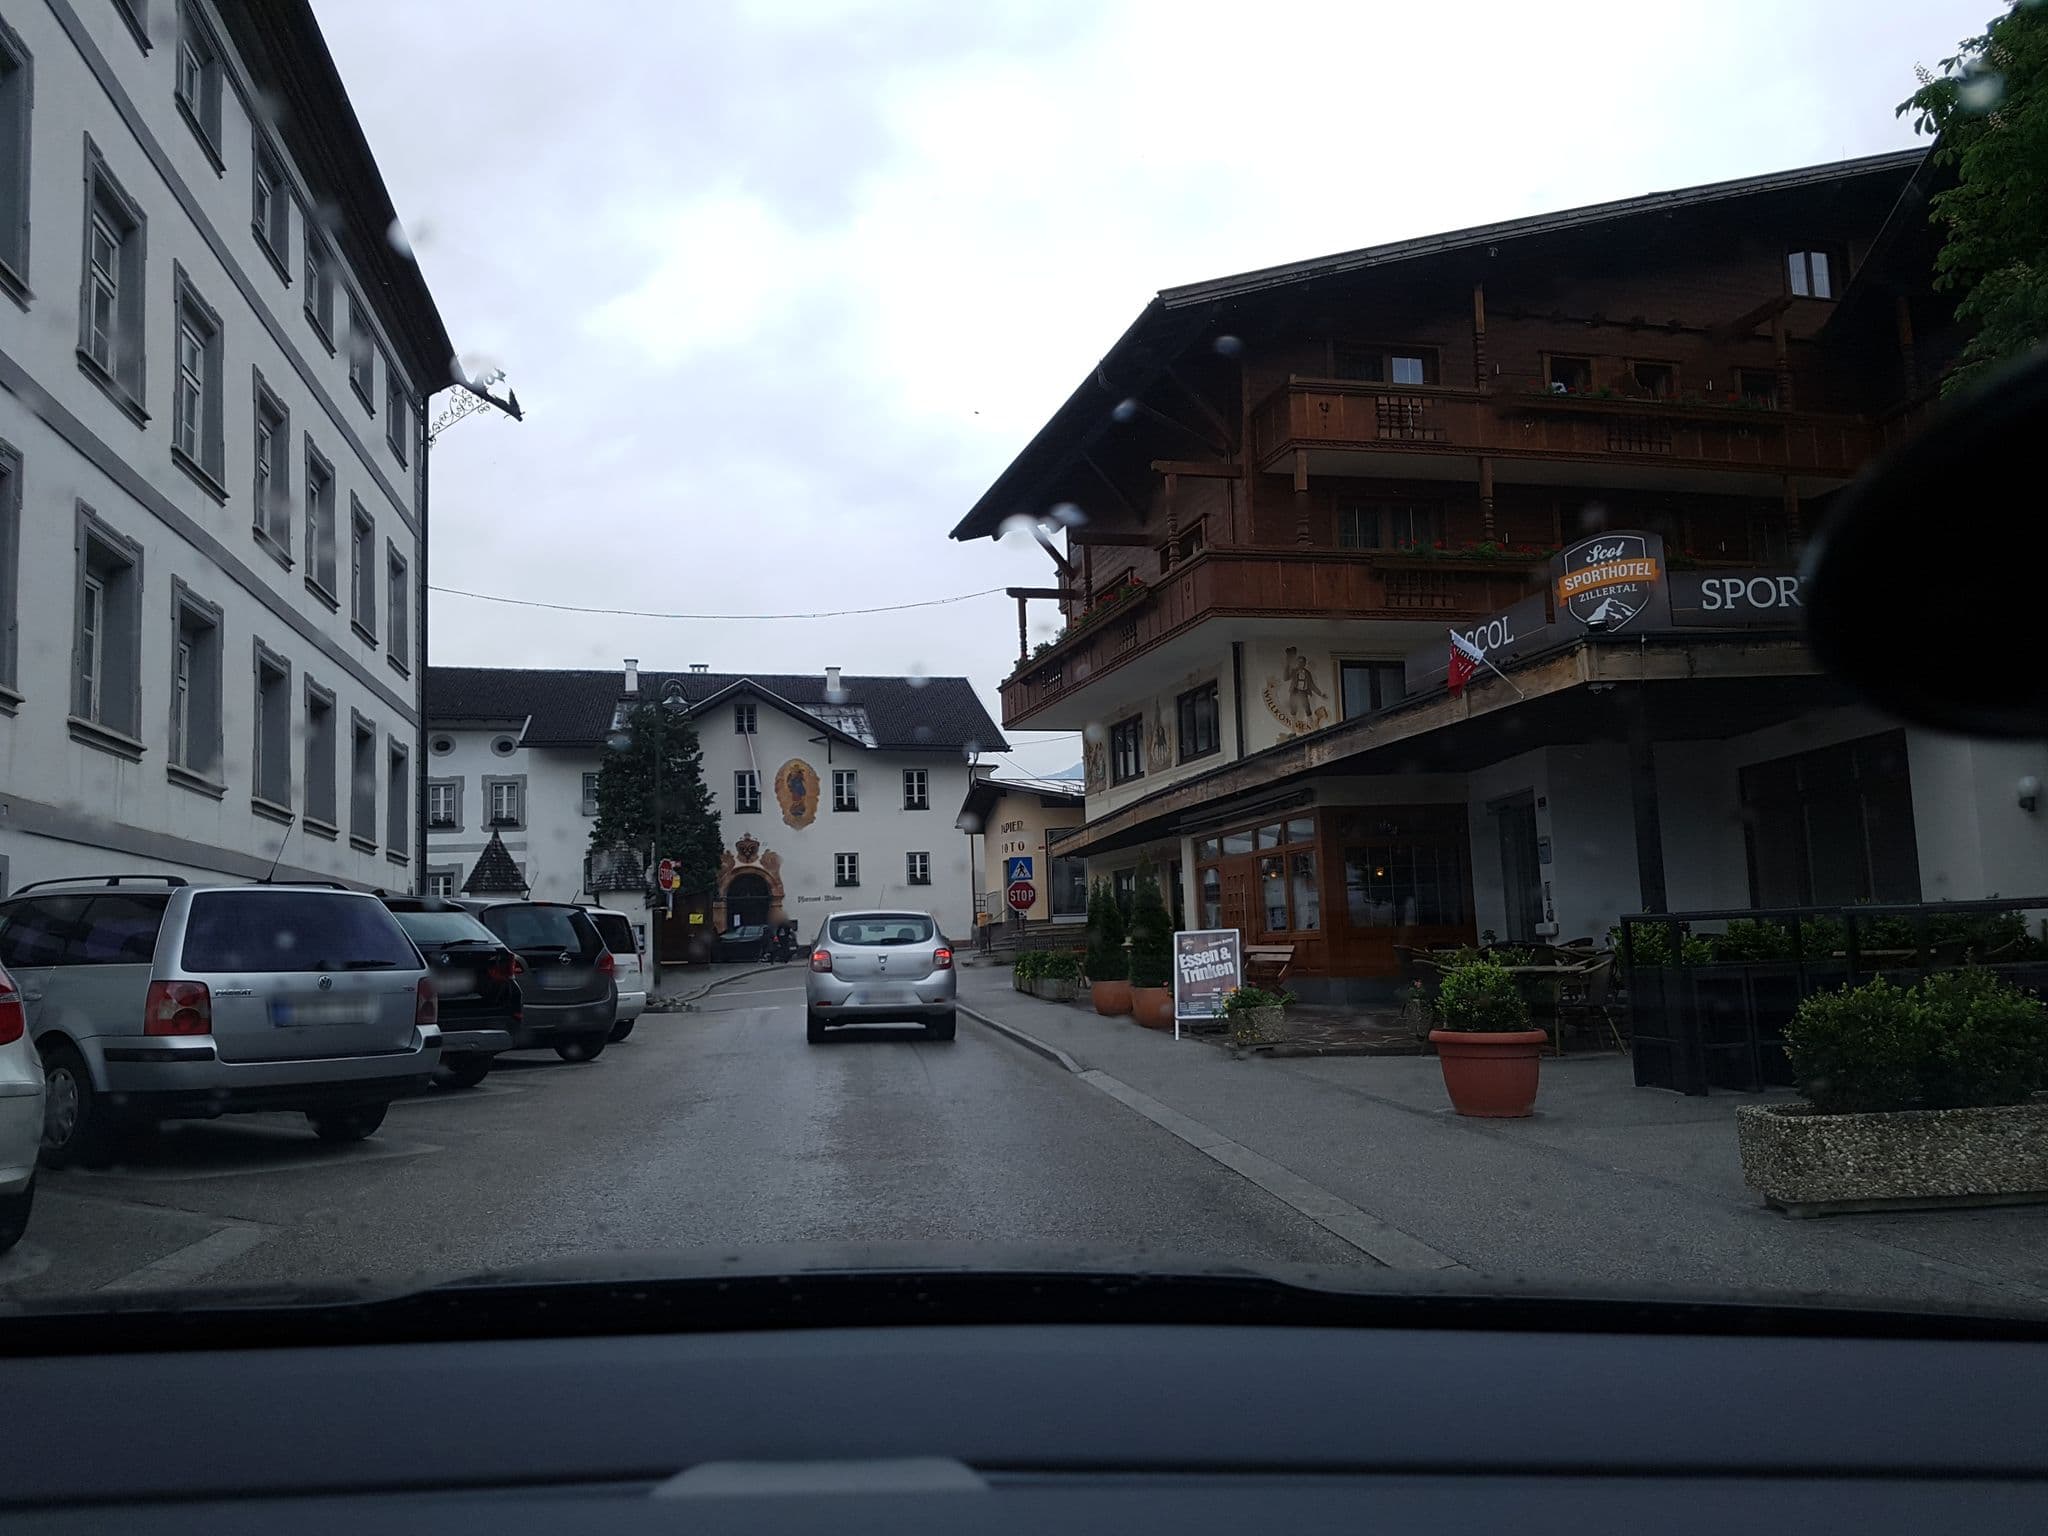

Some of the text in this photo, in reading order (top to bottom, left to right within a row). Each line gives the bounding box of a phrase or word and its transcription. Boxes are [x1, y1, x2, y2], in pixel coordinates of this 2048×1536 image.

[1586, 541, 1625, 563] Scol
[1565, 562, 1652, 591] SPORTHOTEL
[1578, 583, 1638, 603] ZILLERTAL
[1702, 575, 1807, 610] SPOR
[1010, 889, 1034, 902] STOP
[1178, 946, 1232, 969] Essen &
[1181, 961, 1235, 984] Trinken
